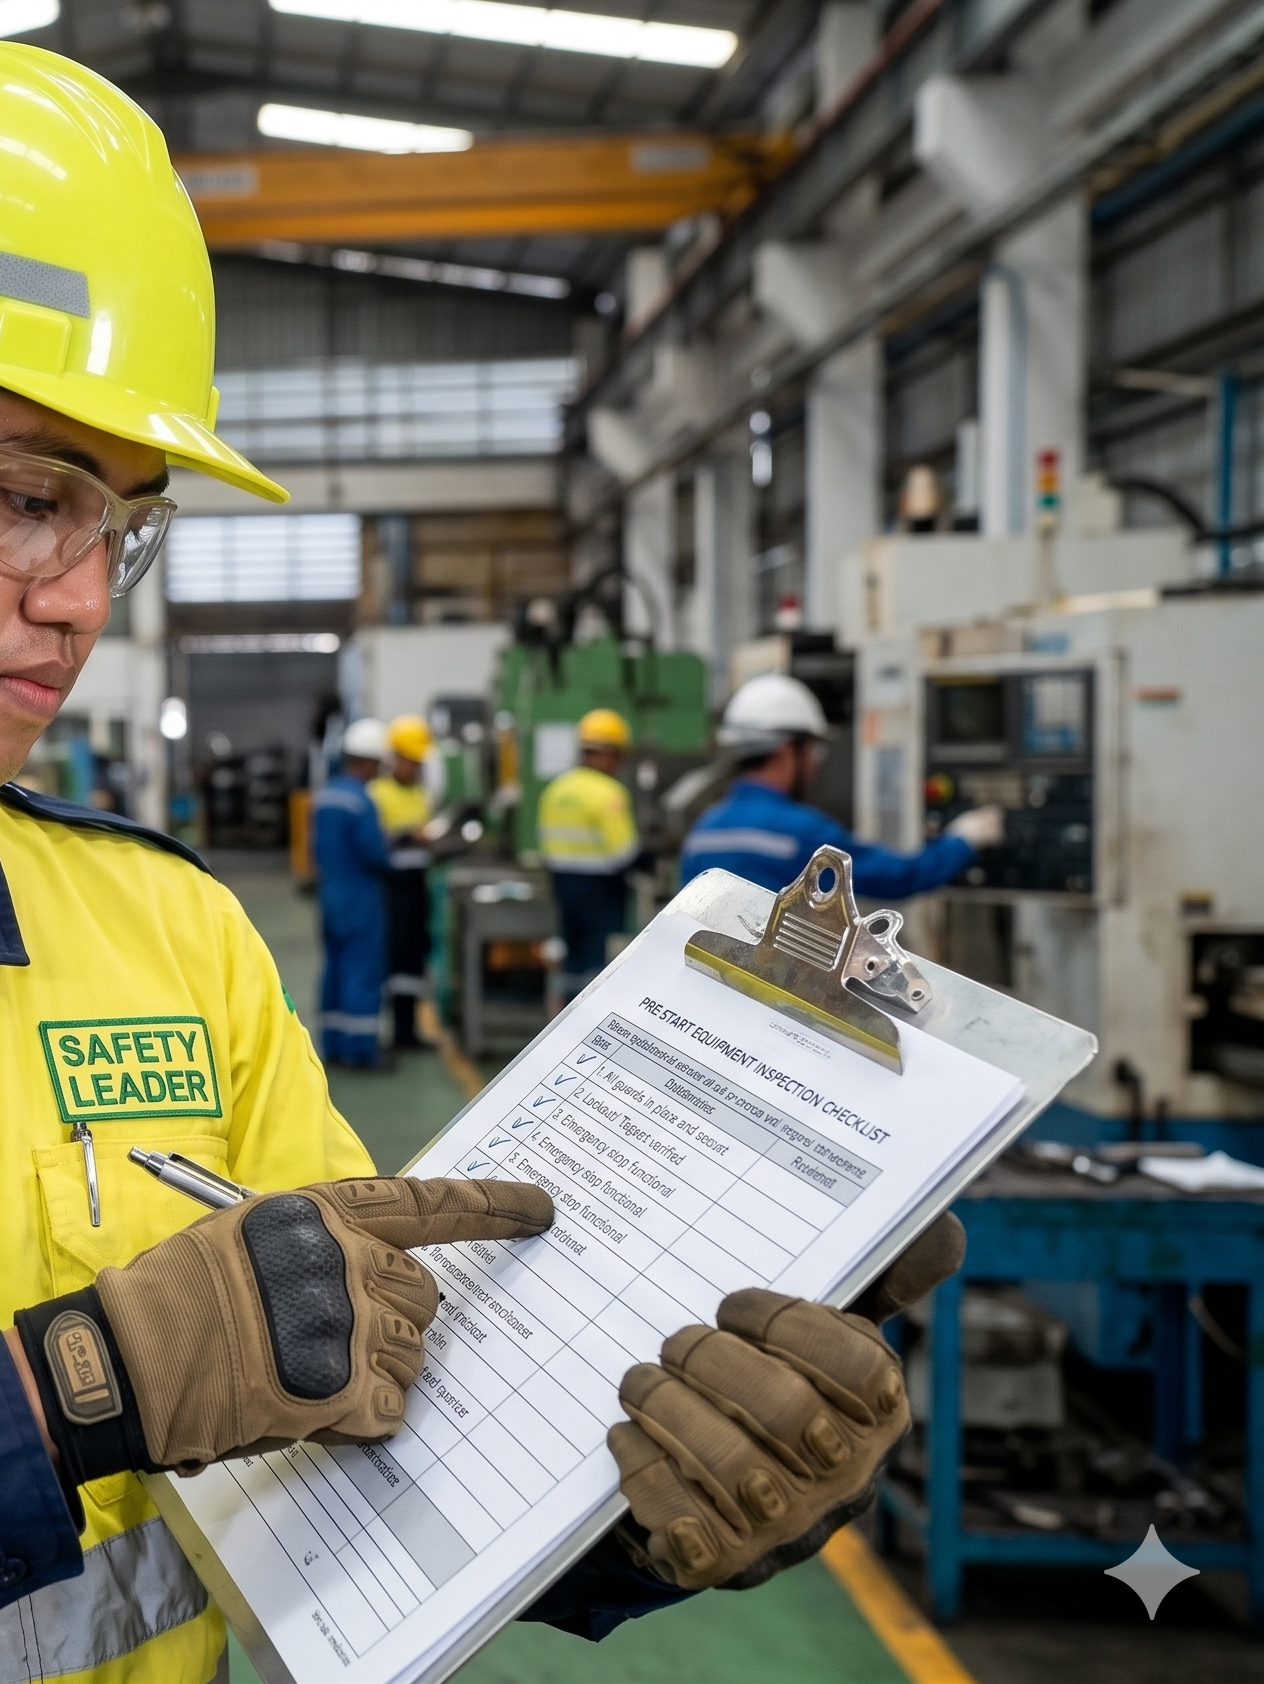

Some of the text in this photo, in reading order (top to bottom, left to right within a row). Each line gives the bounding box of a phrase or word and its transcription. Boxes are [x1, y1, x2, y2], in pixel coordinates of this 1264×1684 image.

[58, 1030, 197, 1067] SAFETY
[68, 1069, 209, 1108] LEADER
[691, 1027, 758, 1068] EQUIPMENT
[753, 1062, 824, 1107] INSPECTION
[822, 1101, 891, 1144] CHECKLIST
[677, 1120, 700, 1135] and
